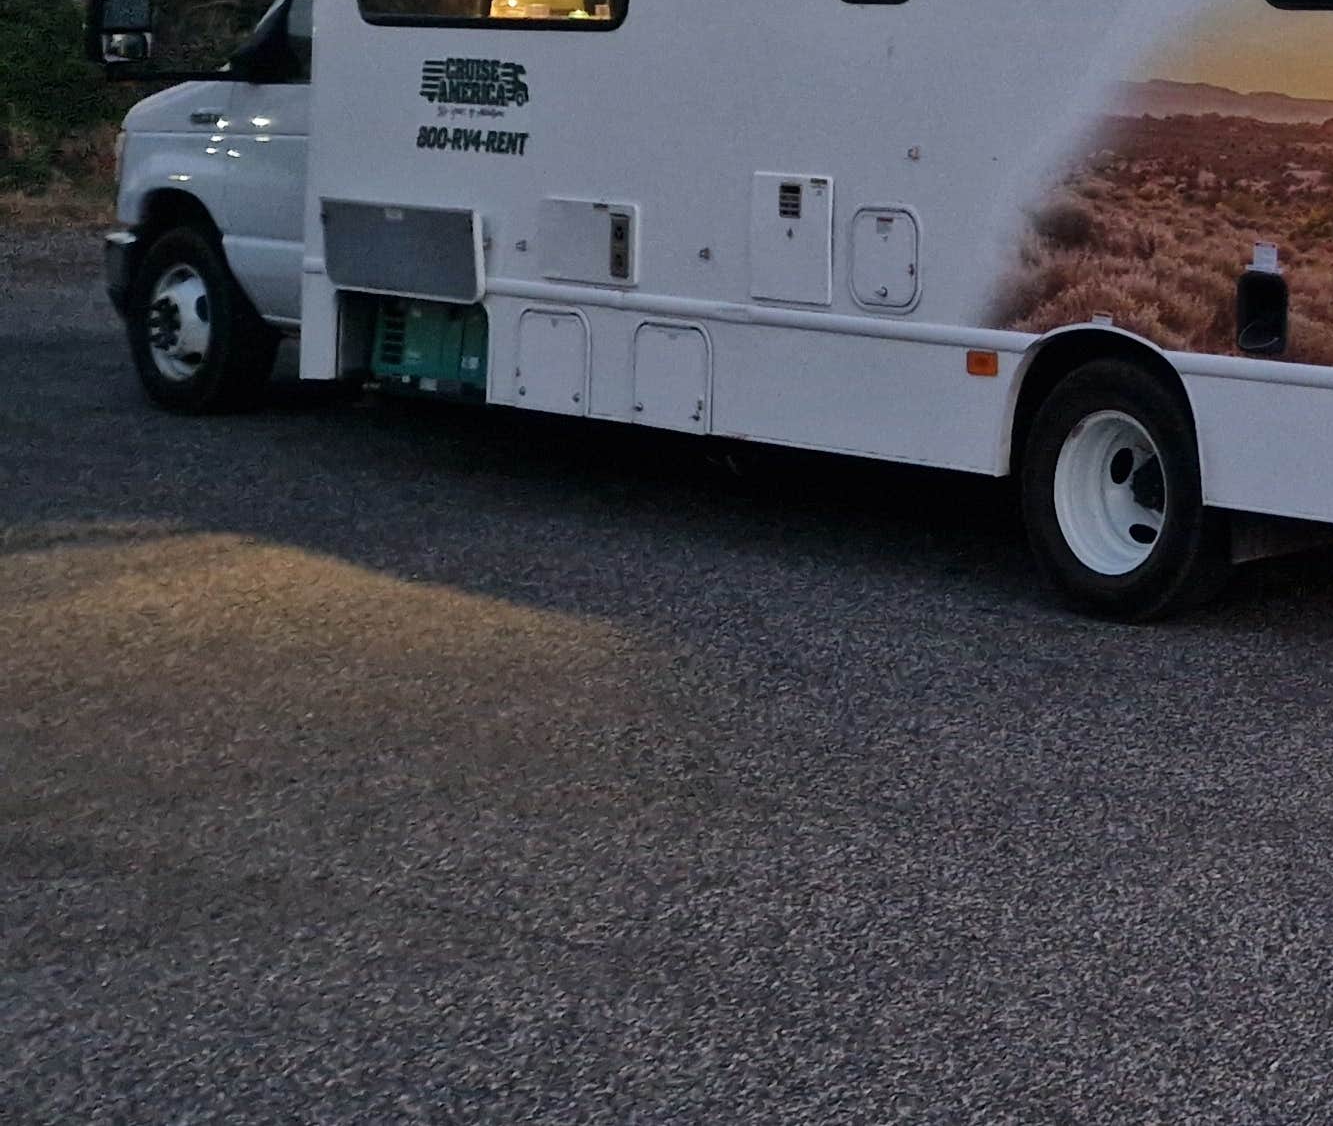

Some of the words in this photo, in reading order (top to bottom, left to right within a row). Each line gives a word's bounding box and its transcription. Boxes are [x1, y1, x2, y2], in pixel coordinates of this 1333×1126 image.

[445, 58, 501, 82] CRUISE
[438, 80, 508, 107] AMERICA
[417, 126, 529, 156] 800-RV4-RENT
